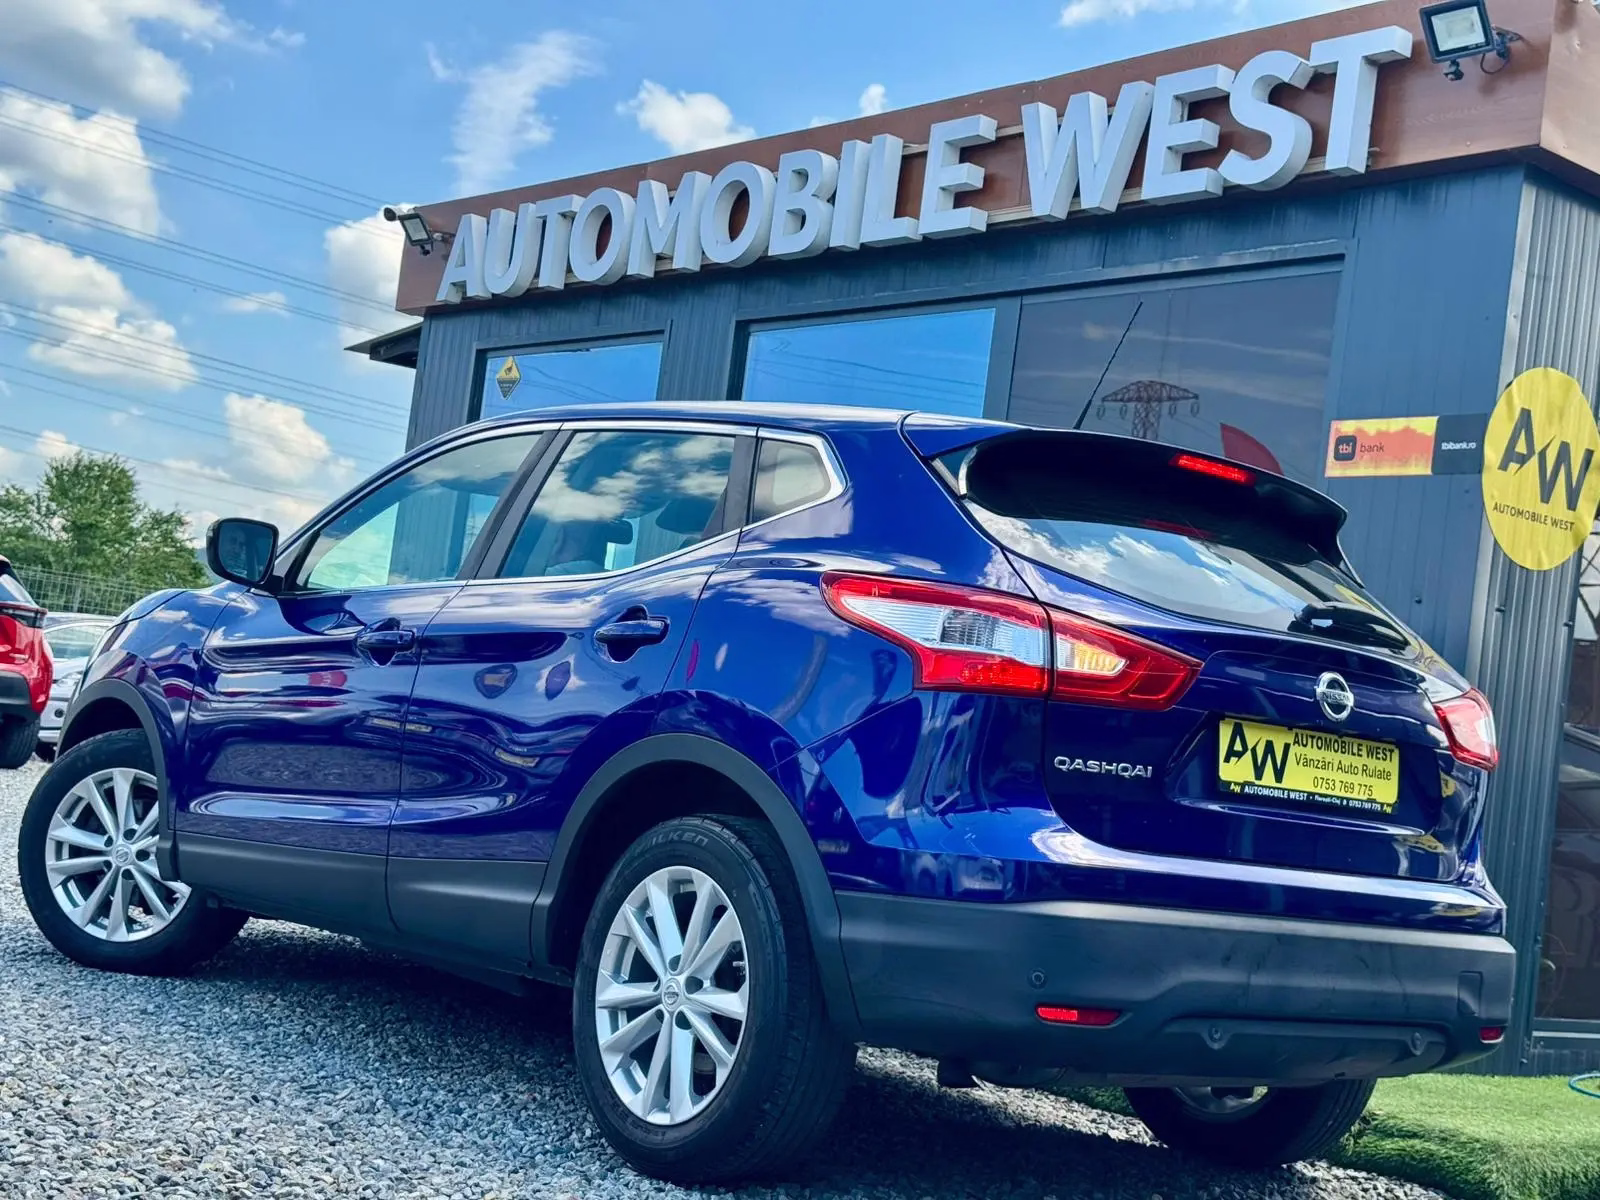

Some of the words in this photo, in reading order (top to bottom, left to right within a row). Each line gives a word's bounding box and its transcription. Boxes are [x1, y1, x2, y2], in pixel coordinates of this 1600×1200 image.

[437, 114, 998, 303] AUTOMOBILE
[1021, 26, 1413, 222] WEST
[1338, 442, 1353, 453] tbi
[1360, 442, 1385, 454] bank
[1492, 502, 1548, 526] AUTOMOBILE
[1550, 515, 1575, 532] WEST
[1292, 732, 1363, 757] AUTOMOBILE
[1365, 744, 1395, 763] WEST
[1054, 755, 1153, 779] QASHQAI
[1336, 760, 1359, 776] Auto
[1361, 763, 1392, 781] Rulate
[1244, 785, 1288, 799] AUTOMOBILE
[1289, 792, 1308, 801] WEST
[1312, 776, 1336, 792] 0753
[1338, 780, 1355, 794] 769
[1357, 783, 1373, 797] 775
